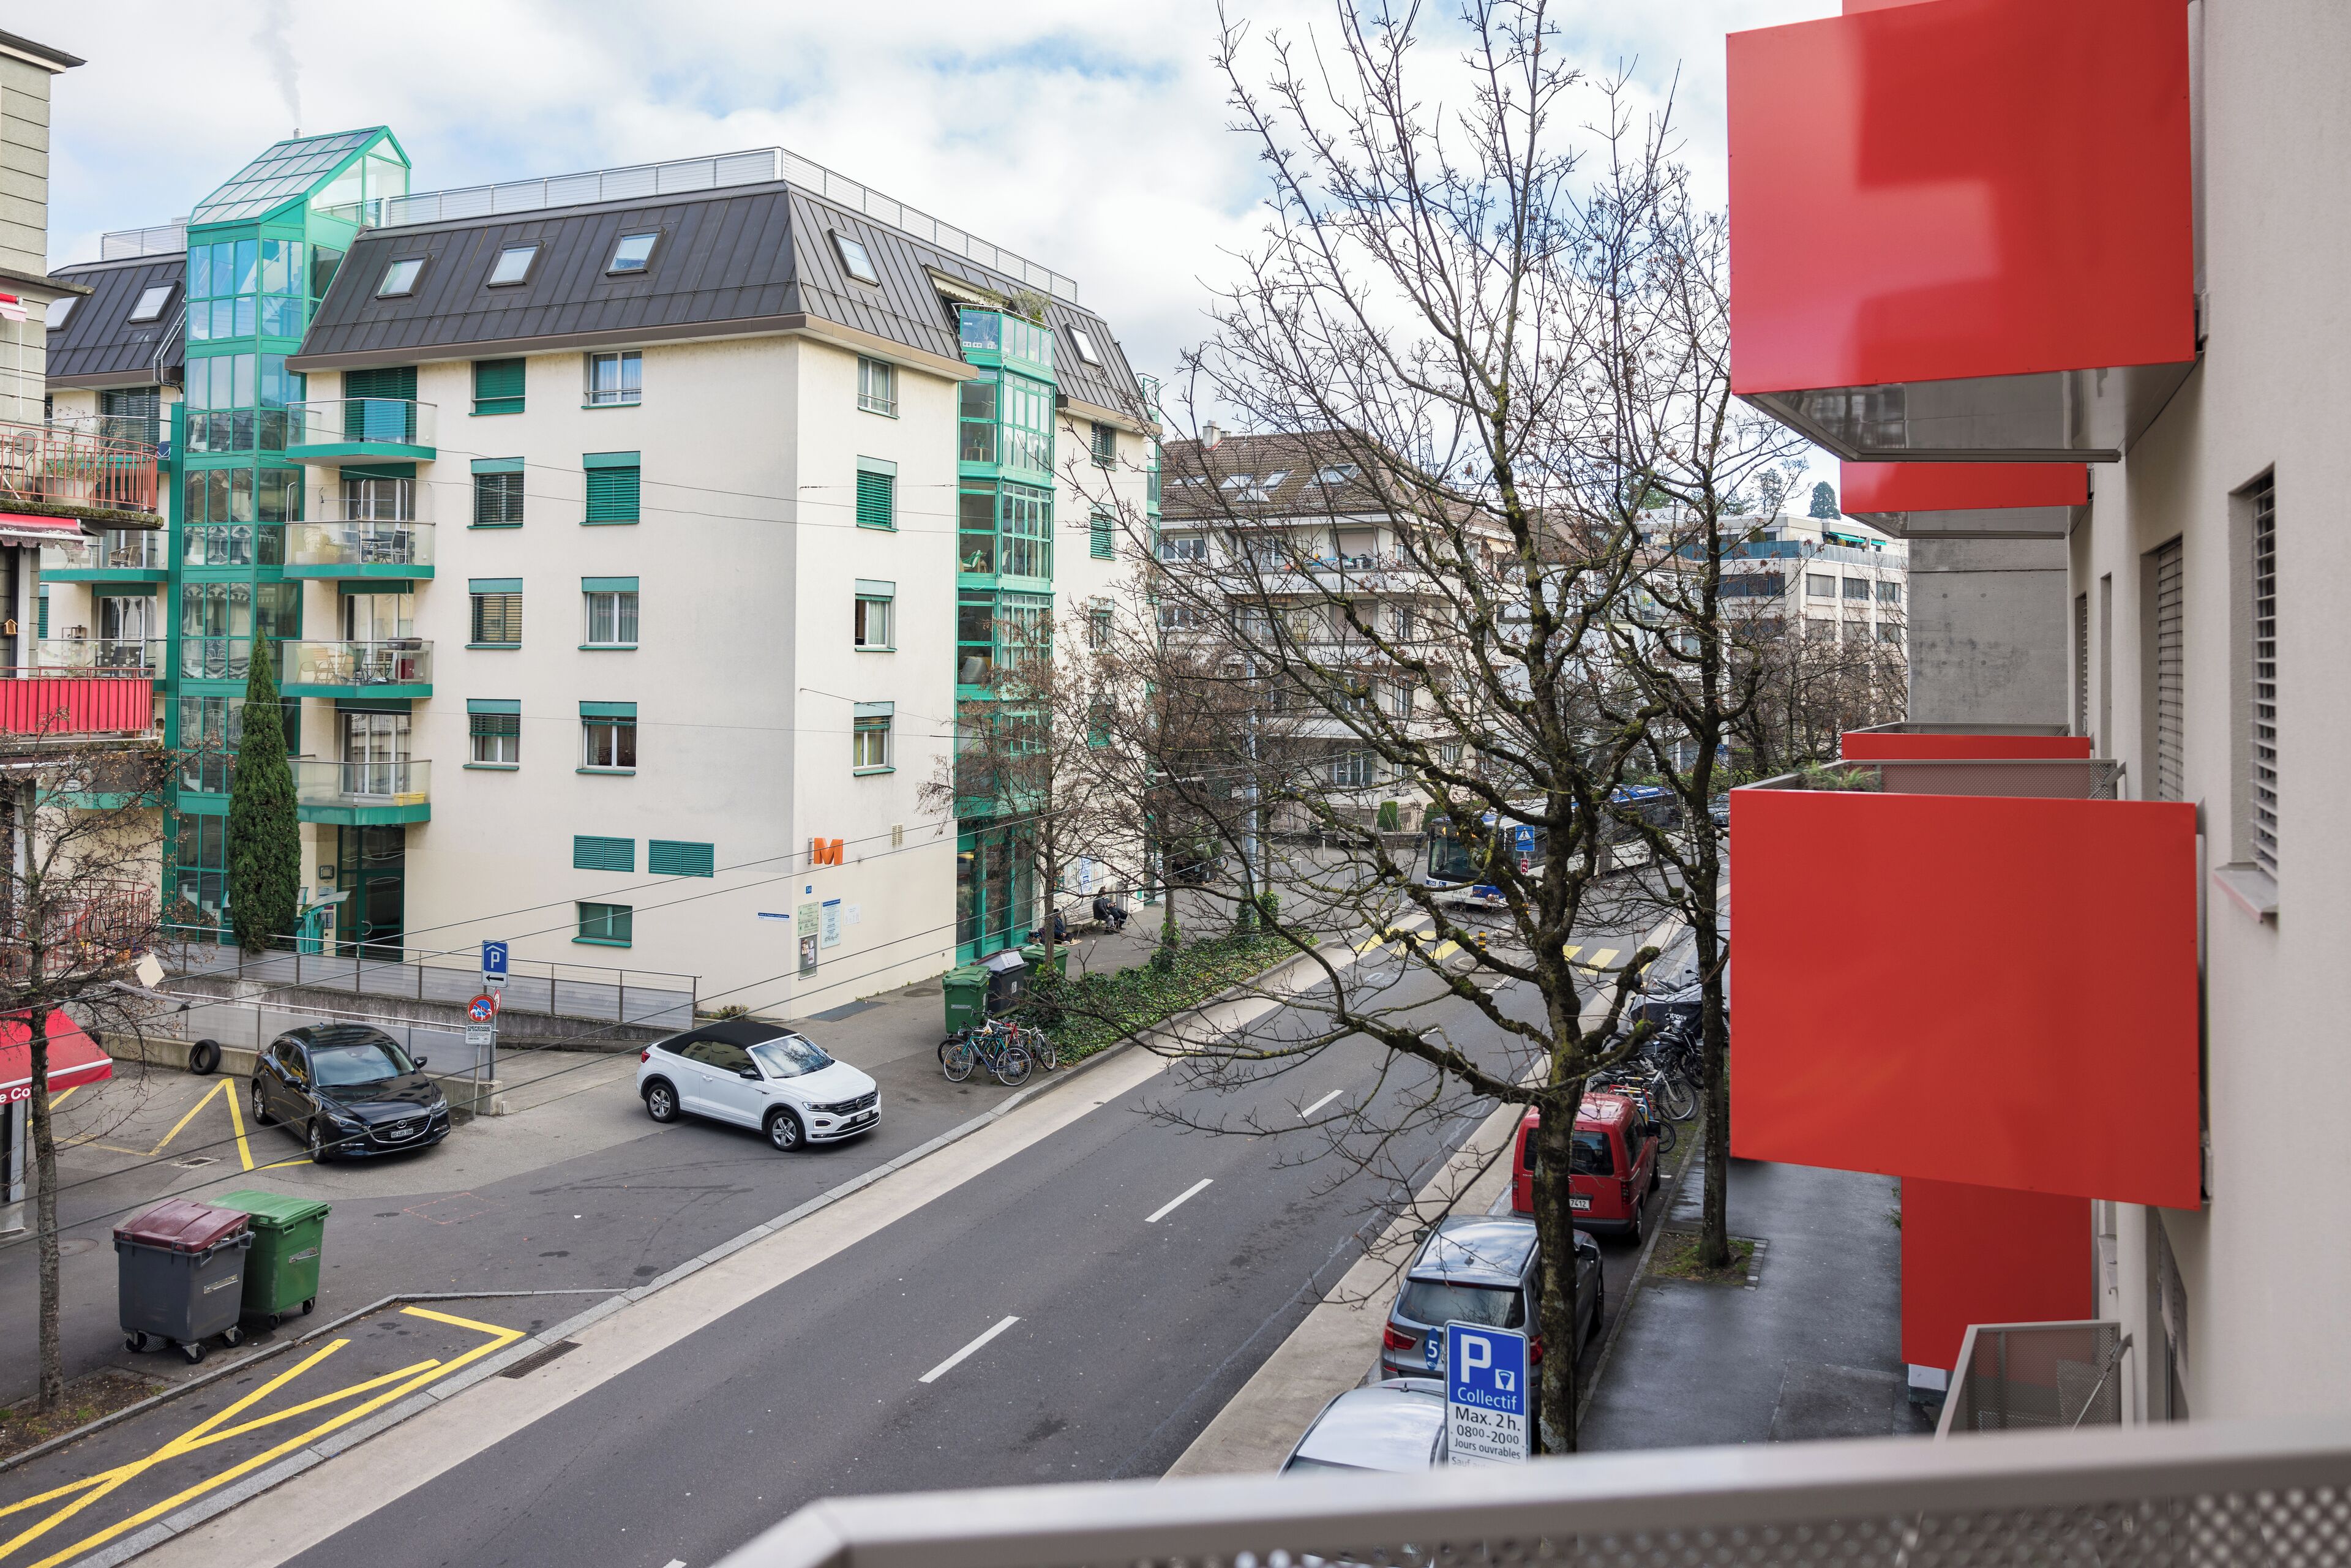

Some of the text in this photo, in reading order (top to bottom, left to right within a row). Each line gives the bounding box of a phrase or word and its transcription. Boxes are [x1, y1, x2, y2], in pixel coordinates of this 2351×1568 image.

[814, 837, 843, 865] M
[490, 951, 500, 968] P
[11, 1086, 32, 1100] Co
[1428, 1340, 1438, 1358] 5
[1460, 1334, 1491, 1384] P
[1458, 1387, 1517, 1410] Collectif
[1456, 1406, 1491, 1425] Max.
[1455, 1438, 1521, 1460] Jours ouvrables
[1452, 1457, 1471, 1468] Sauf
